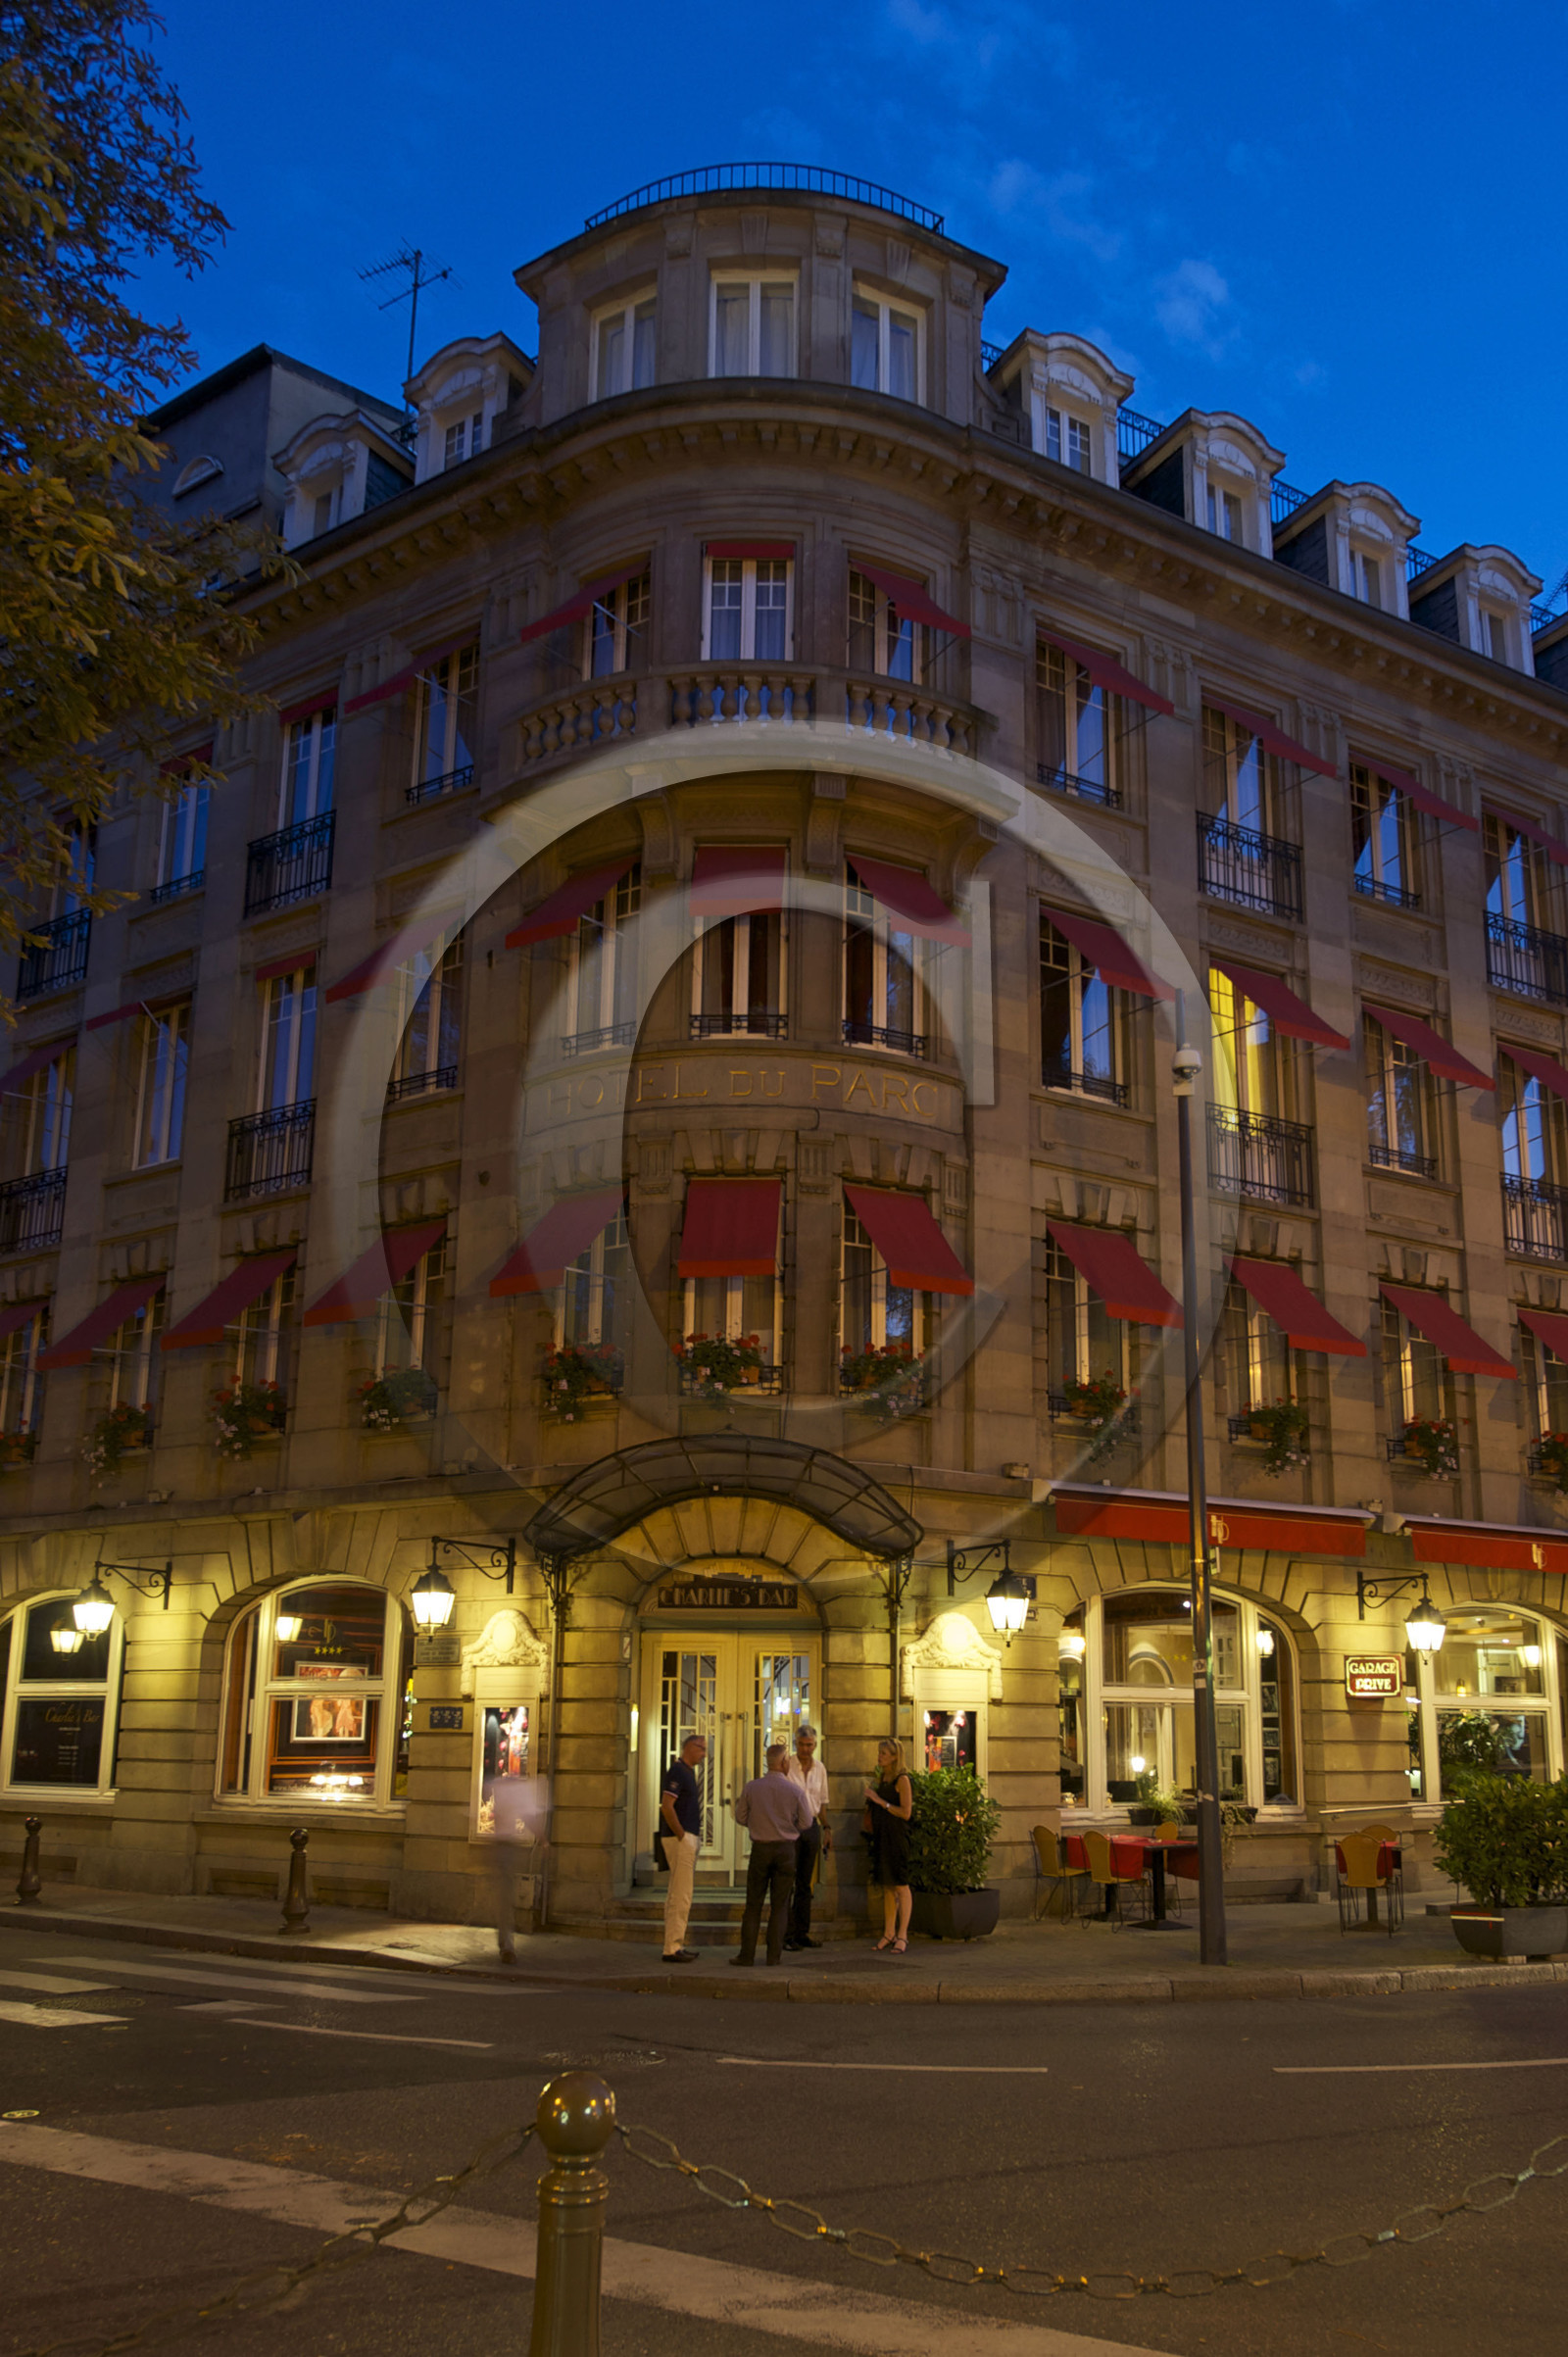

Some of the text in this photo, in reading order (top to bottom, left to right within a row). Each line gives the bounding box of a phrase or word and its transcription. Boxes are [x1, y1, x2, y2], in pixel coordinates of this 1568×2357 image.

[547, 1061, 939, 1119] HOTEL DU PARC
[660, 1587, 795, 1606] CHARLIE'S BAR
[1348, 1662, 1396, 1674] GARAGE
[1355, 1678, 1393, 1691] PRIVE
